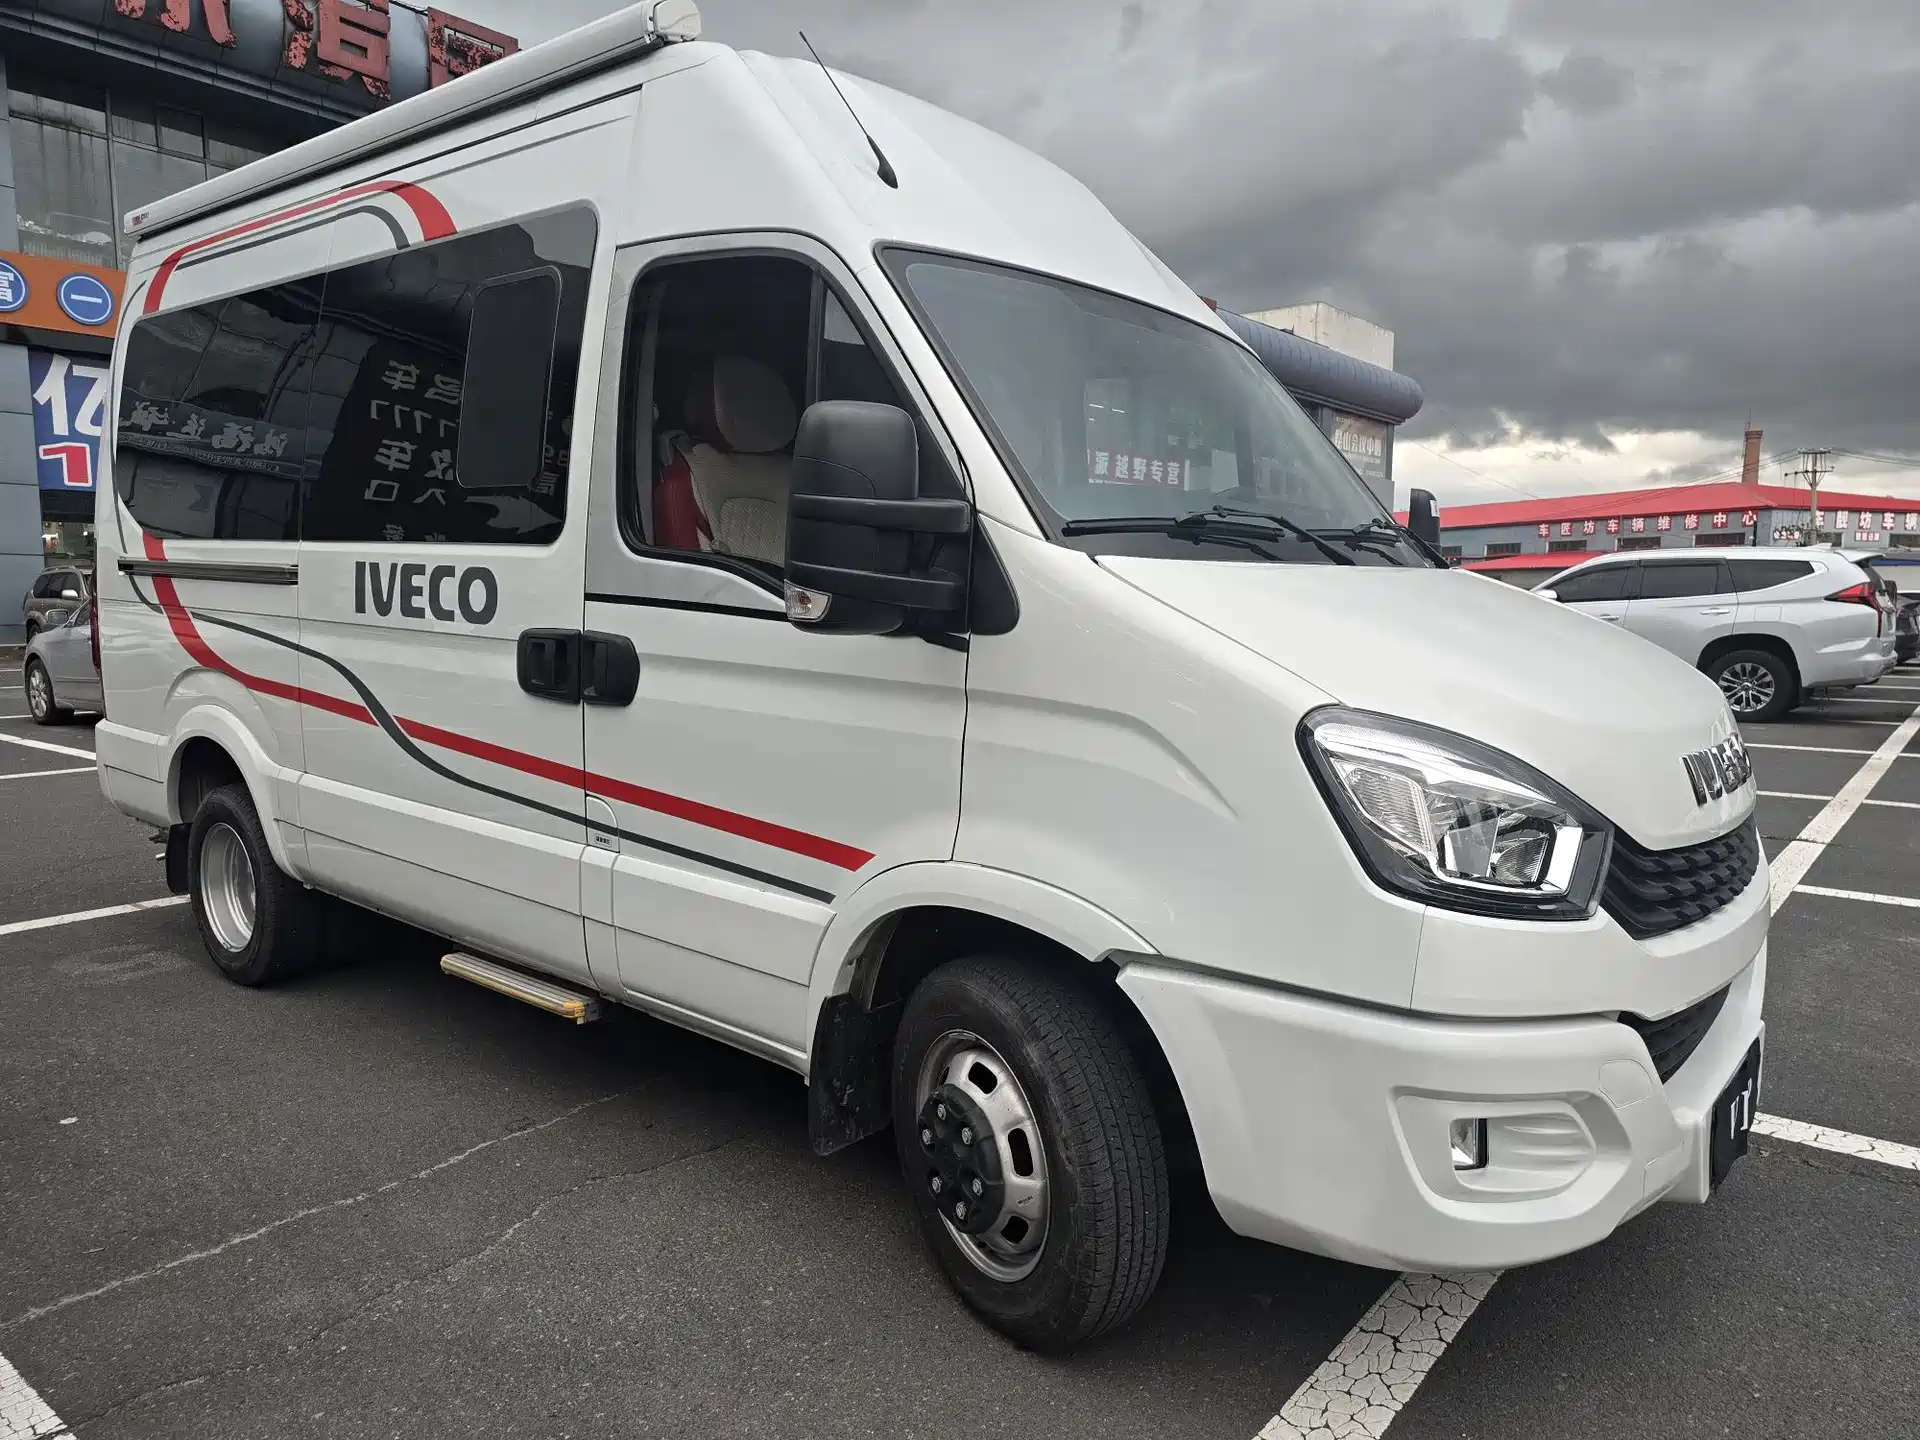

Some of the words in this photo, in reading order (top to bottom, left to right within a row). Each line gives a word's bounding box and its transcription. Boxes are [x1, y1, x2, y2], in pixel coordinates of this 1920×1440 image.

[1538, 510, 1757, 537] 车匠坊车辆维修中心
[355, 561, 498, 625] IVECO
